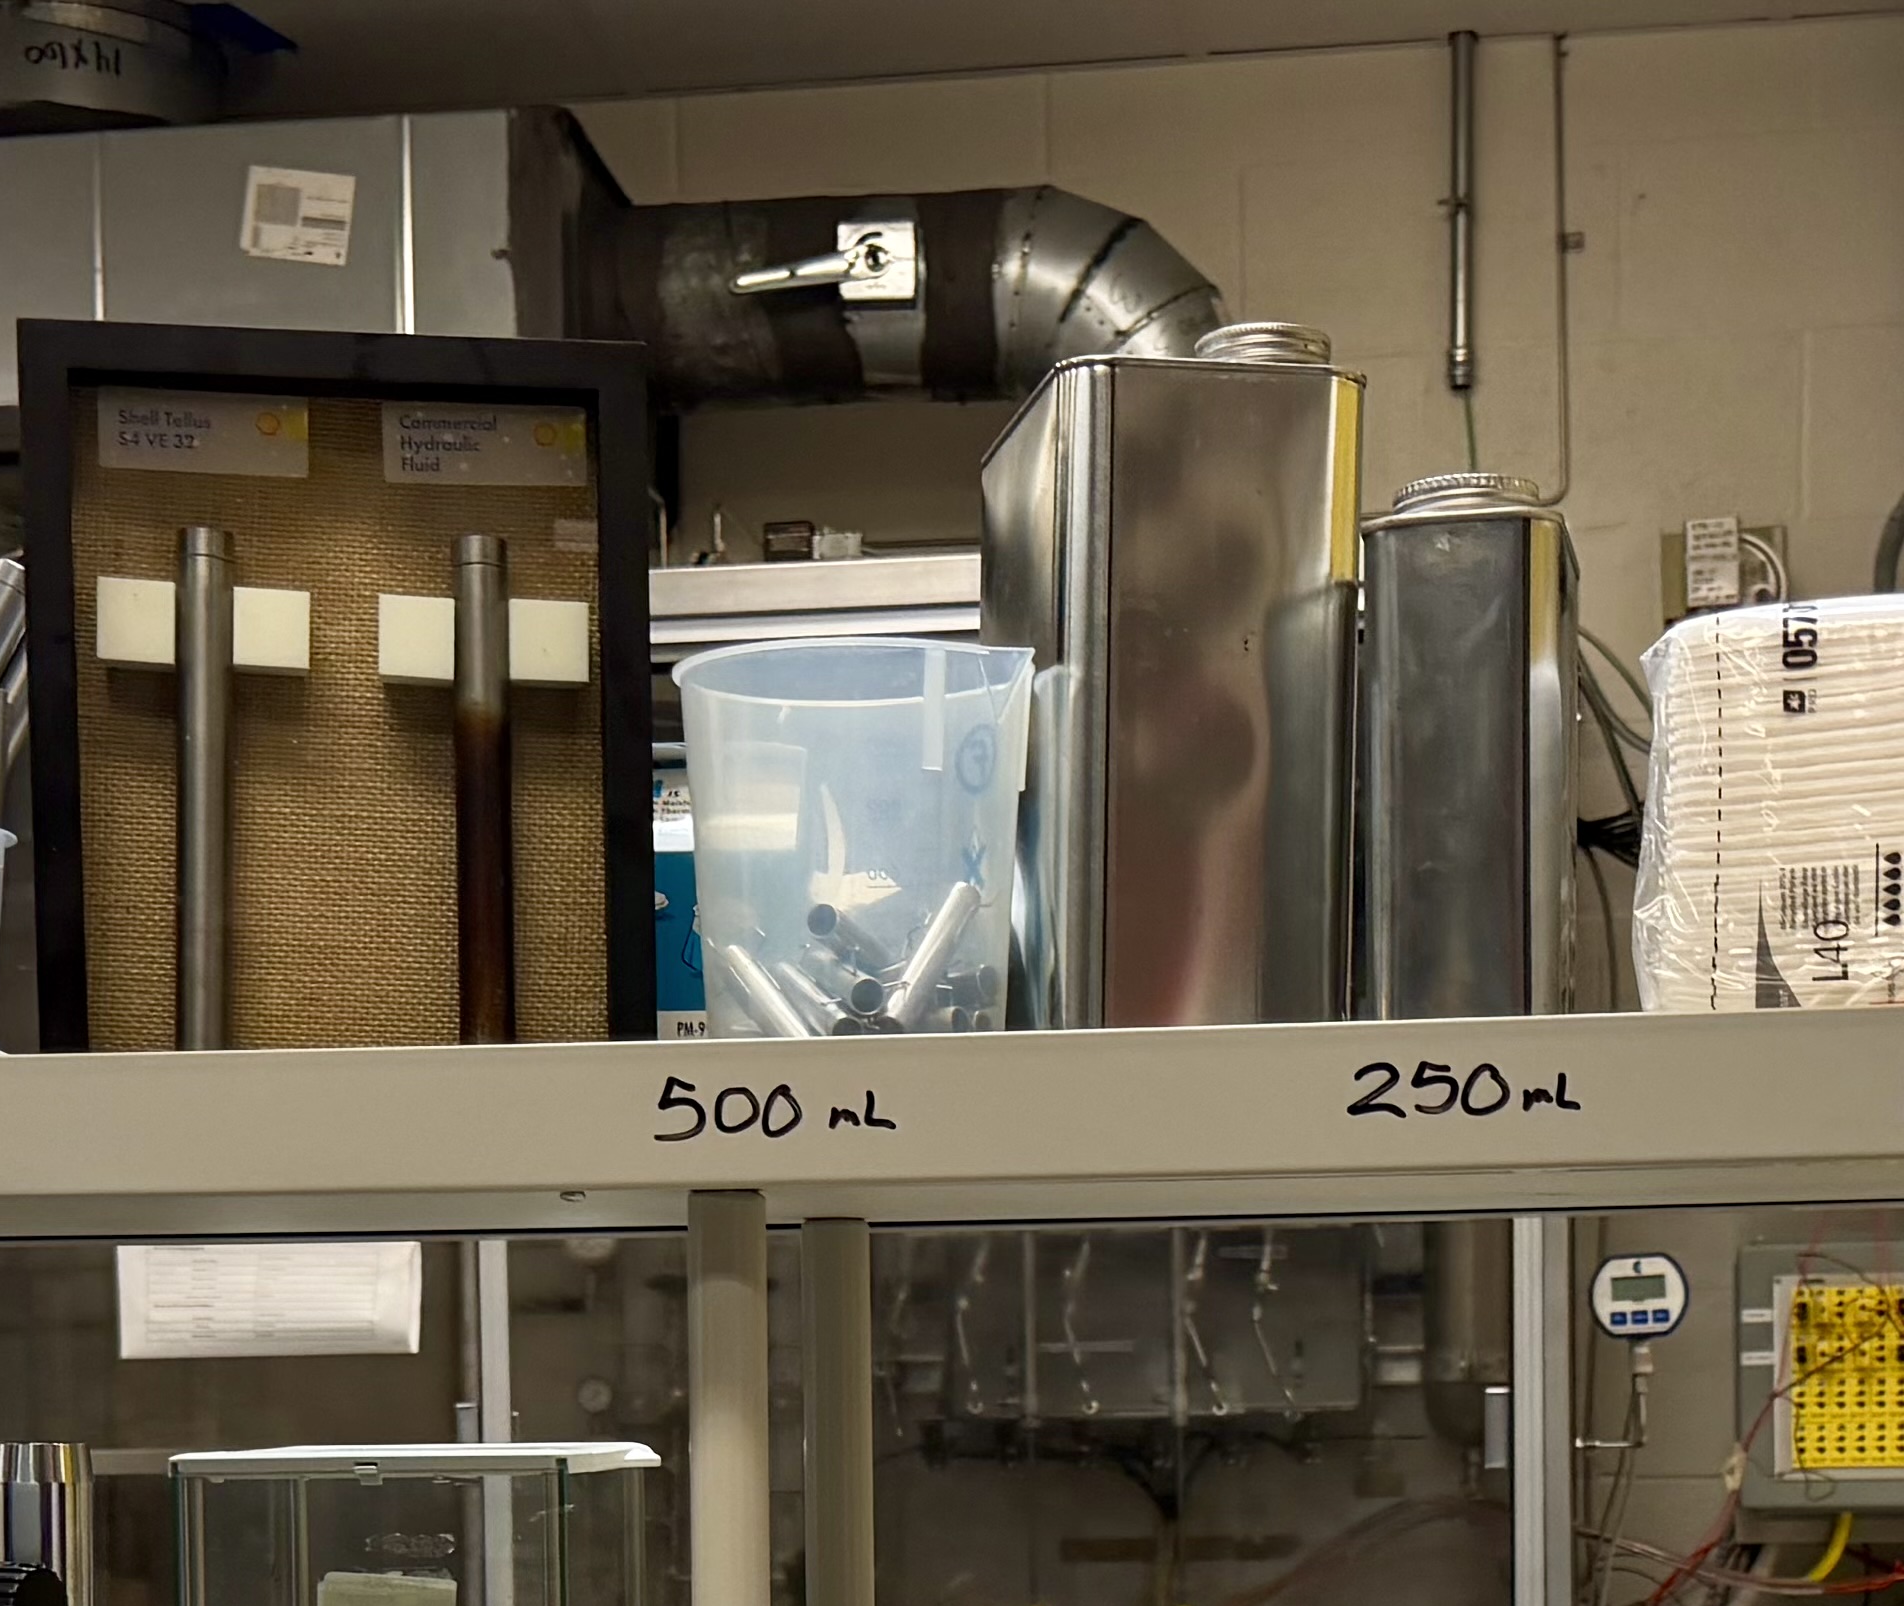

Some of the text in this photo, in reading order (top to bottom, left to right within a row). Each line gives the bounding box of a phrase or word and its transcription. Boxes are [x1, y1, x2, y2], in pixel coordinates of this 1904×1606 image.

[400, 435, 482, 454] Hydraulic
[401, 456, 441, 474] Fluid
[1812, 919, 1850, 982] L40
[652, 1075, 896, 1142] 500 mL
